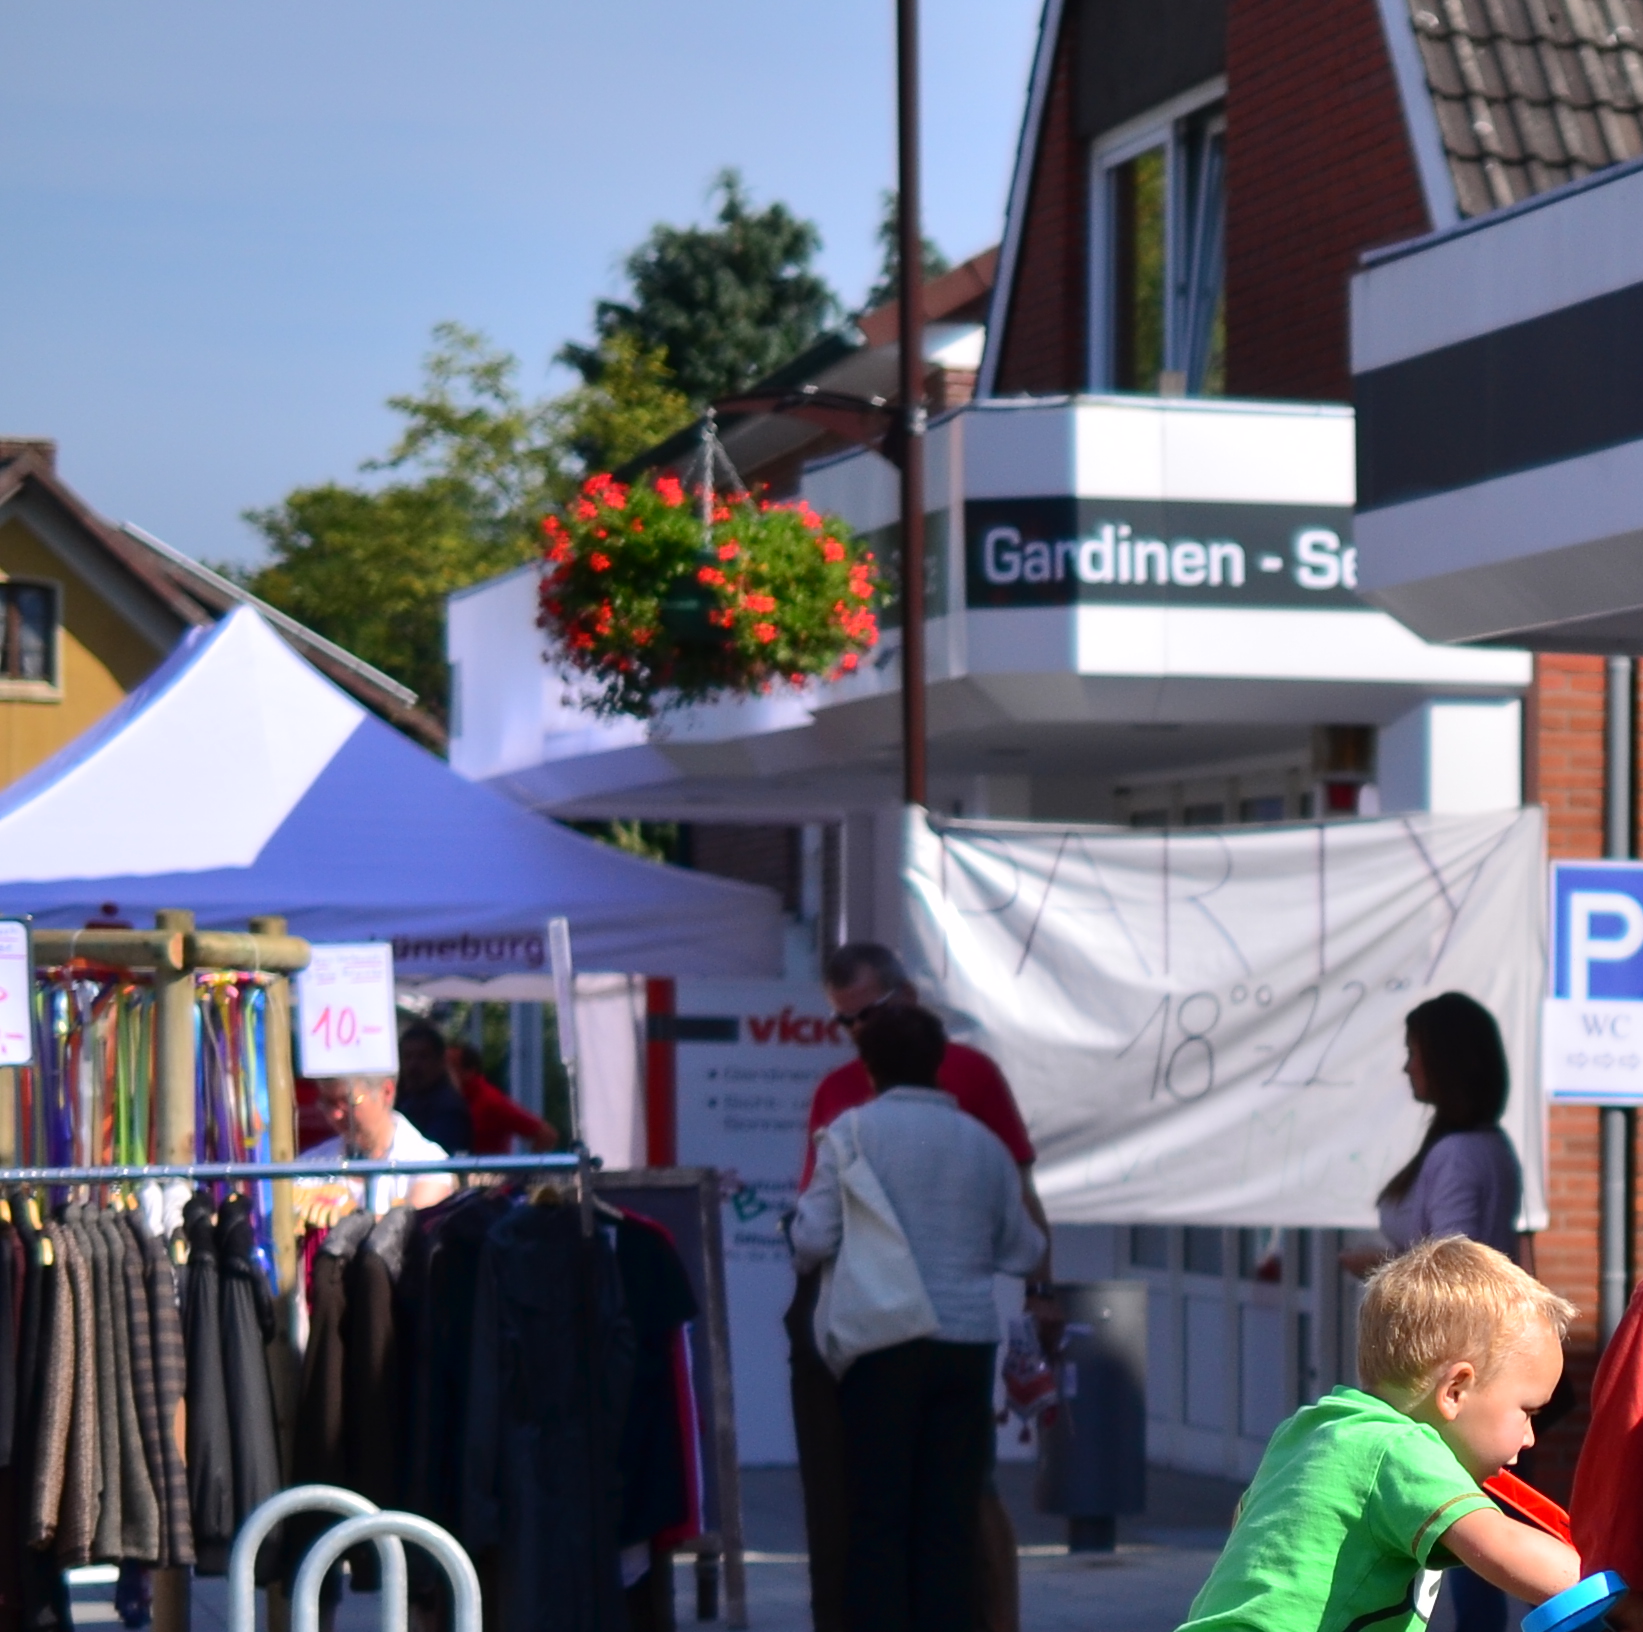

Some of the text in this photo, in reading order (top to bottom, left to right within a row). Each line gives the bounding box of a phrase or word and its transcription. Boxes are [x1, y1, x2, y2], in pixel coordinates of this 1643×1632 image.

[983, 524, 1246, 588] Gardinen
[942, 812, 1524, 984] PARTY
[391, 934, 545, 970] üneburg
[1581, 1012, 1632, 1041] WC
